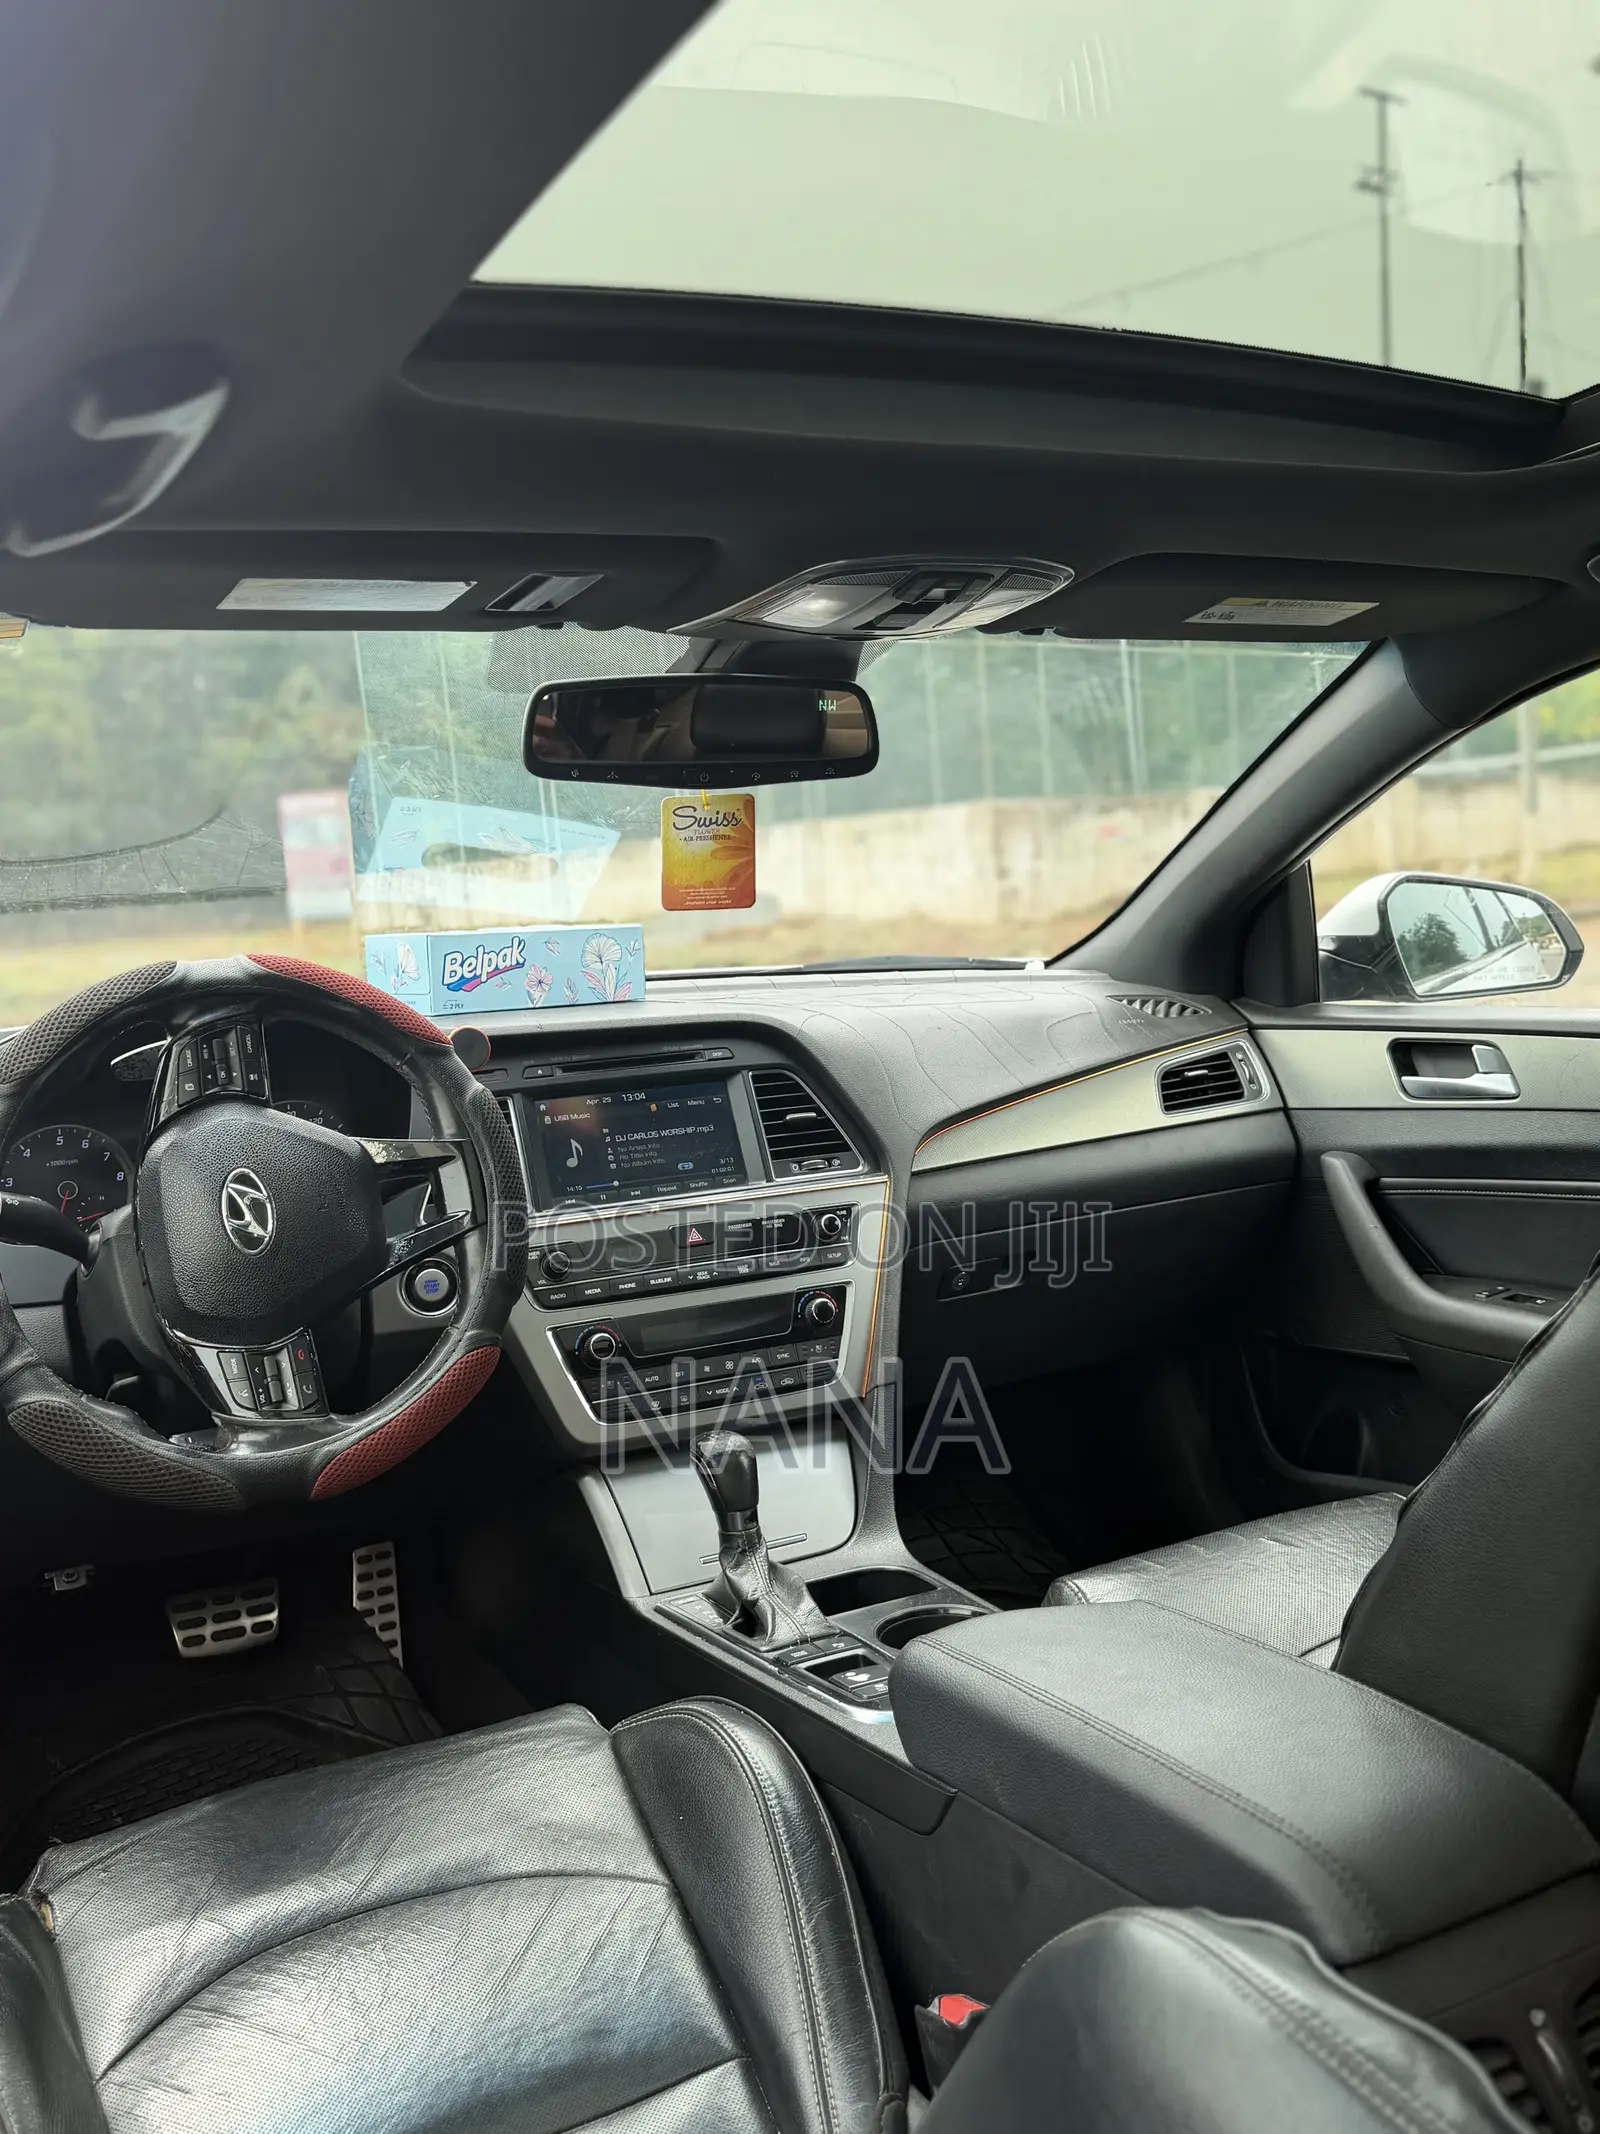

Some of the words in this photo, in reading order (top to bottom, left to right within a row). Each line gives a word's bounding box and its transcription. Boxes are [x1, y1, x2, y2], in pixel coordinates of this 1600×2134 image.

[818, 699, 837, 712] NW
[672, 805, 742, 831] Swiss
[442, 936, 527, 986] Belpak
[621, 1092, 646, 1102] 13:04
[553, 1114, 570, 1122] USB
[569, 1112, 591, 1120] Music
[615, 1134, 627, 1142] DJ
[627, 1130, 659, 1140] CARLOS
[659, 1124, 715, 1137] WORSHIP.mp3
[55, 1136, 64, 1146] 5
[81, 1139, 89, 1149] 6
[22, 1148, 31, 1158] 4
[103, 1151, 111, 1162] 7
[718, 1156, 735, 1165] 3/13
[116, 1171, 124, 1181] 8
[5, 1177, 13, 1187] 3
[550, 1292, 567, 1300] RADIO
[618, 1282, 637, 1290] PHONE
[649, 1276, 673, 1285] BLUELINK
[827, 1252, 843, 1260] SETUP
[644, 1375, 660, 1383] AUTO
[715, 1387, 731, 1395] MODE
